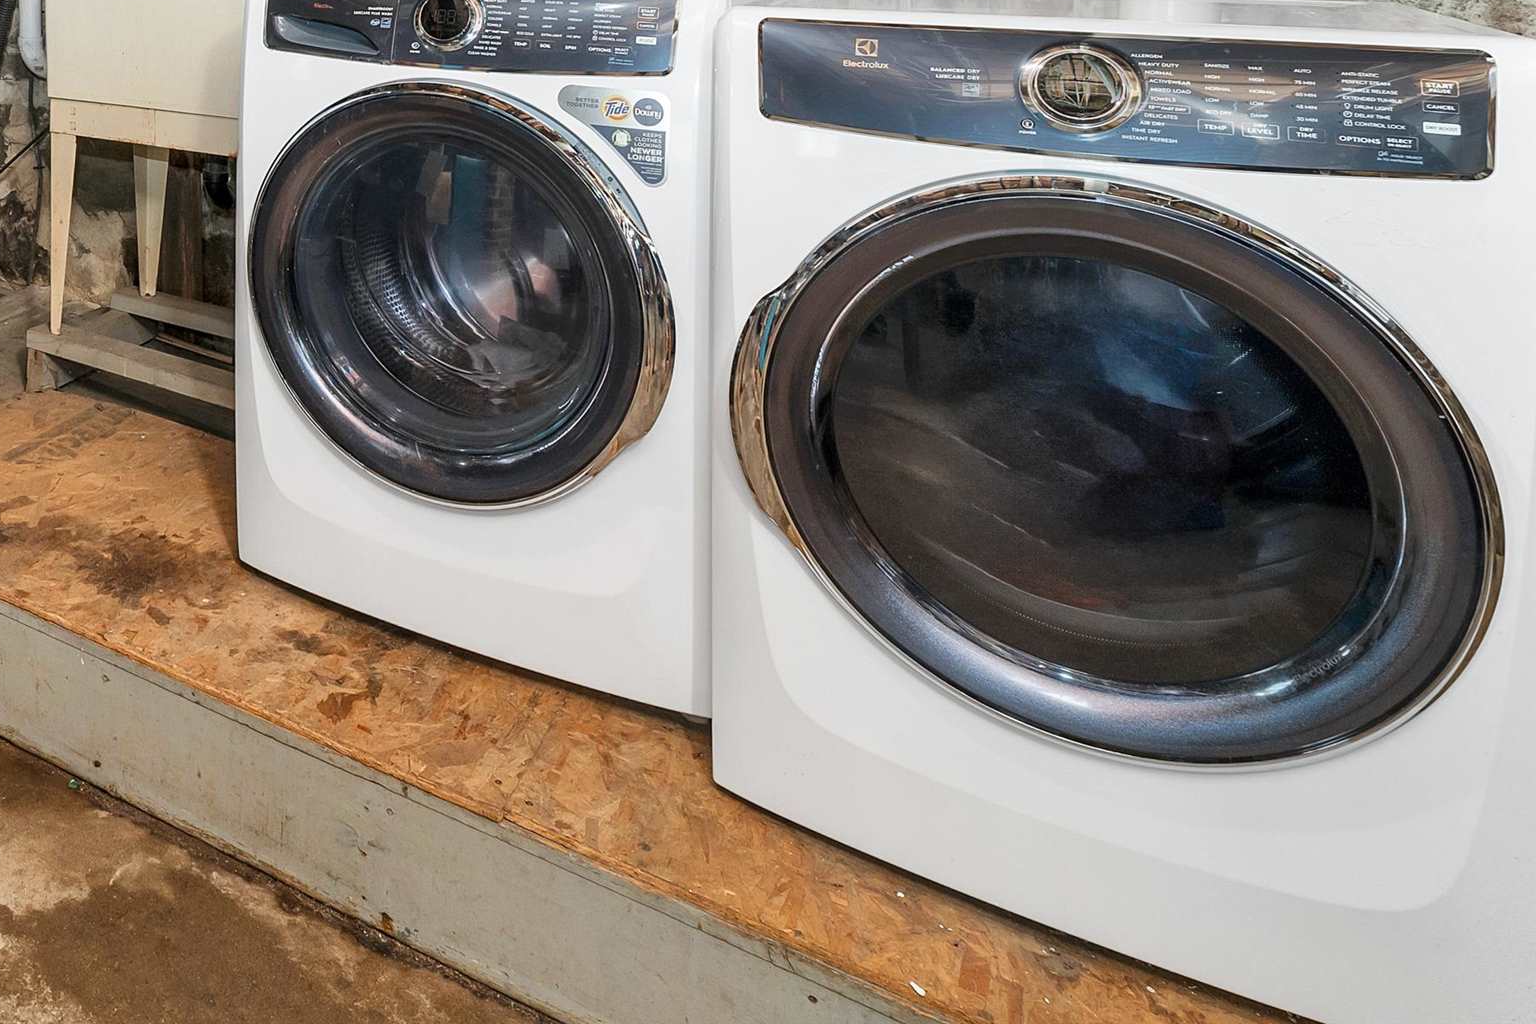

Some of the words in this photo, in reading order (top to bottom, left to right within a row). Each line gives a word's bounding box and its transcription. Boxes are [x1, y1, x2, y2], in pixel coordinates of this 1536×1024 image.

[842, 59, 889, 69] Electrolux
[1342, 95, 1376, 103] EXTENDED
[566, 101, 599, 109] TOGETHER
[604, 99, 630, 117] Tide
[1426, 103, 1456, 111] CANCEL
[634, 107, 662, 119] Downy
[1144, 112, 1179, 120] DELICATES
[1204, 123, 1228, 131] TEMP
[1354, 121, 1386, 129] CONTROL
[1247, 127, 1274, 135] LEVEL
[1296, 131, 1318, 139] TIME
[1149, 136, 1178, 144] REFRESH
[1338, 135, 1382, 145] OPTIONS
[634, 141, 663, 149] LOOKING
[630, 147, 663, 156] NEWER
[627, 153, 663, 163] LONGER
